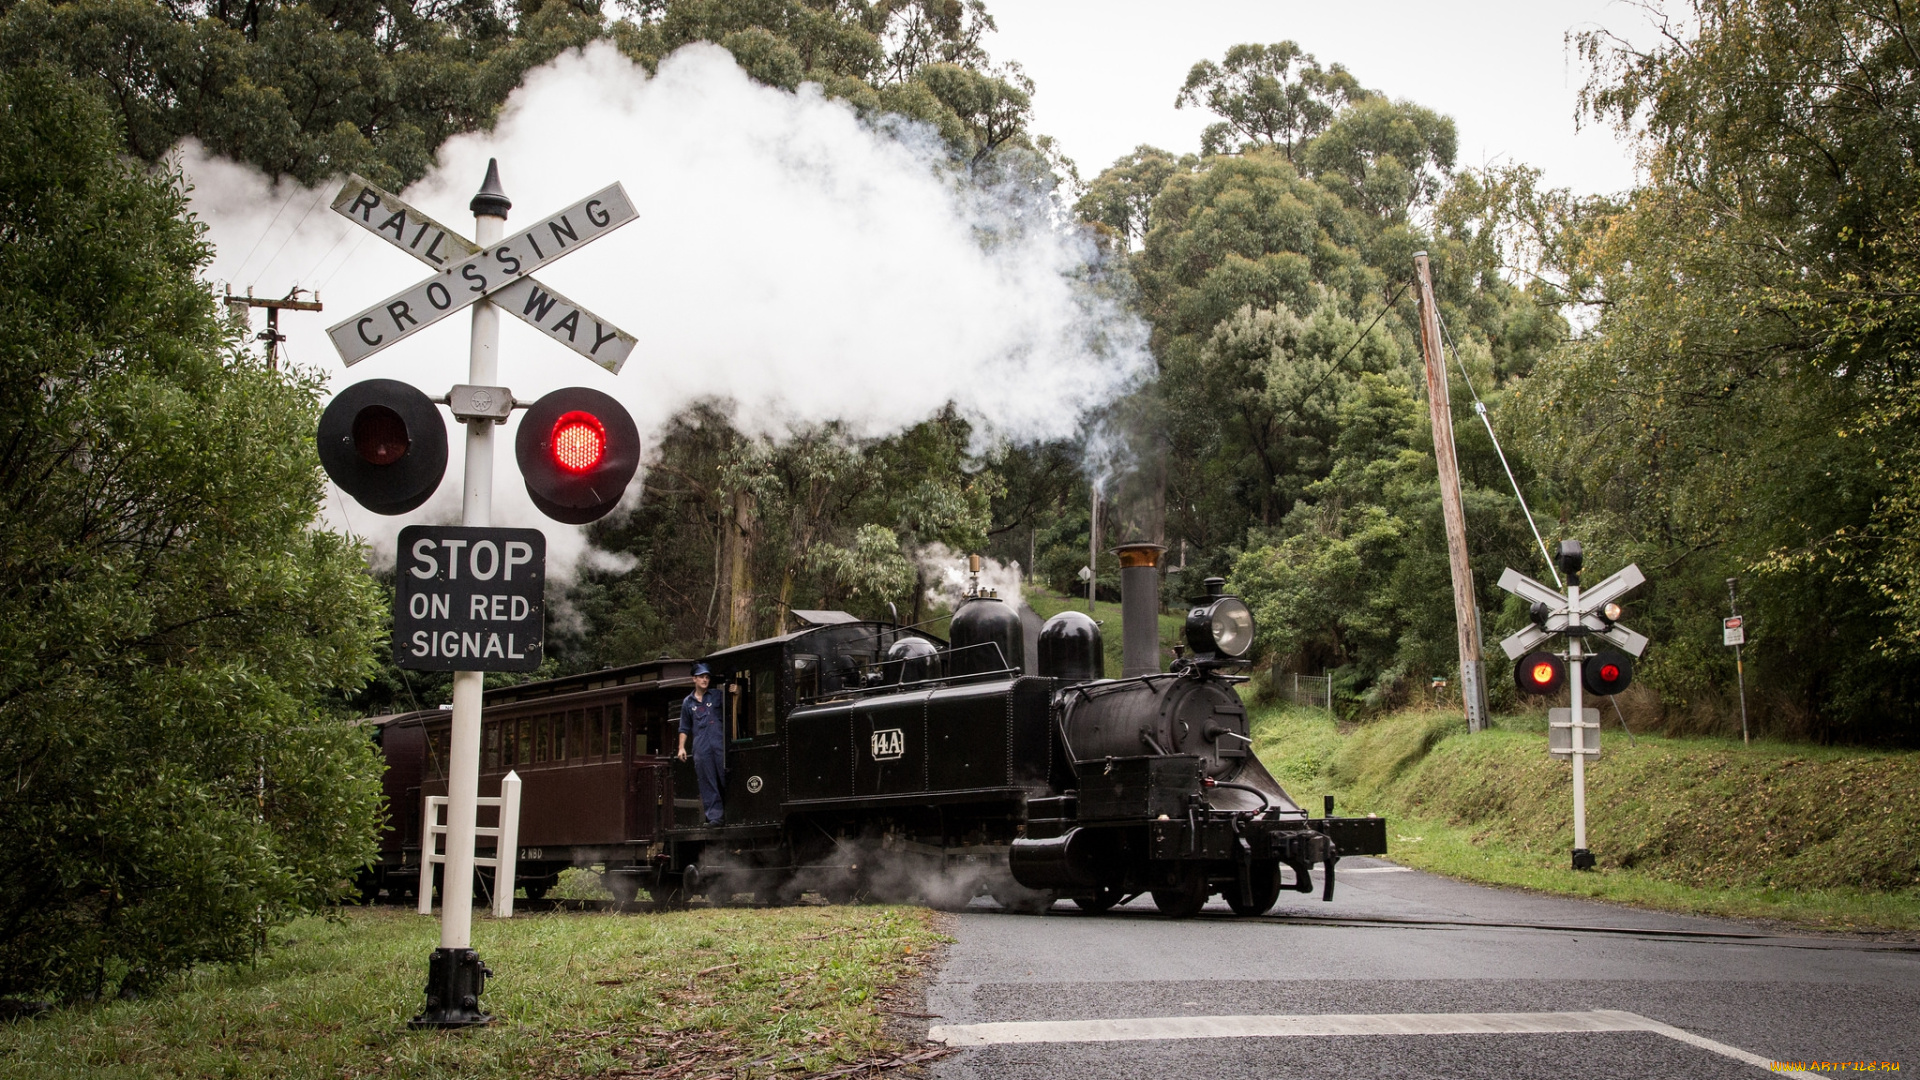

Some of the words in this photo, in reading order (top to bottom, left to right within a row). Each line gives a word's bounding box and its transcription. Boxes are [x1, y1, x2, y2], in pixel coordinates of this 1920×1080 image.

[349, 187, 446, 265] RAIL
[357, 200, 610, 346] CROSSING
[523, 286, 616, 355] WAY
[410, 538, 533, 581] STOP
[409, 593, 450, 620] ON
[470, 594, 530, 621] RED
[411, 630, 525, 659] SIGNAL
[872, 731, 901, 755] 14A
